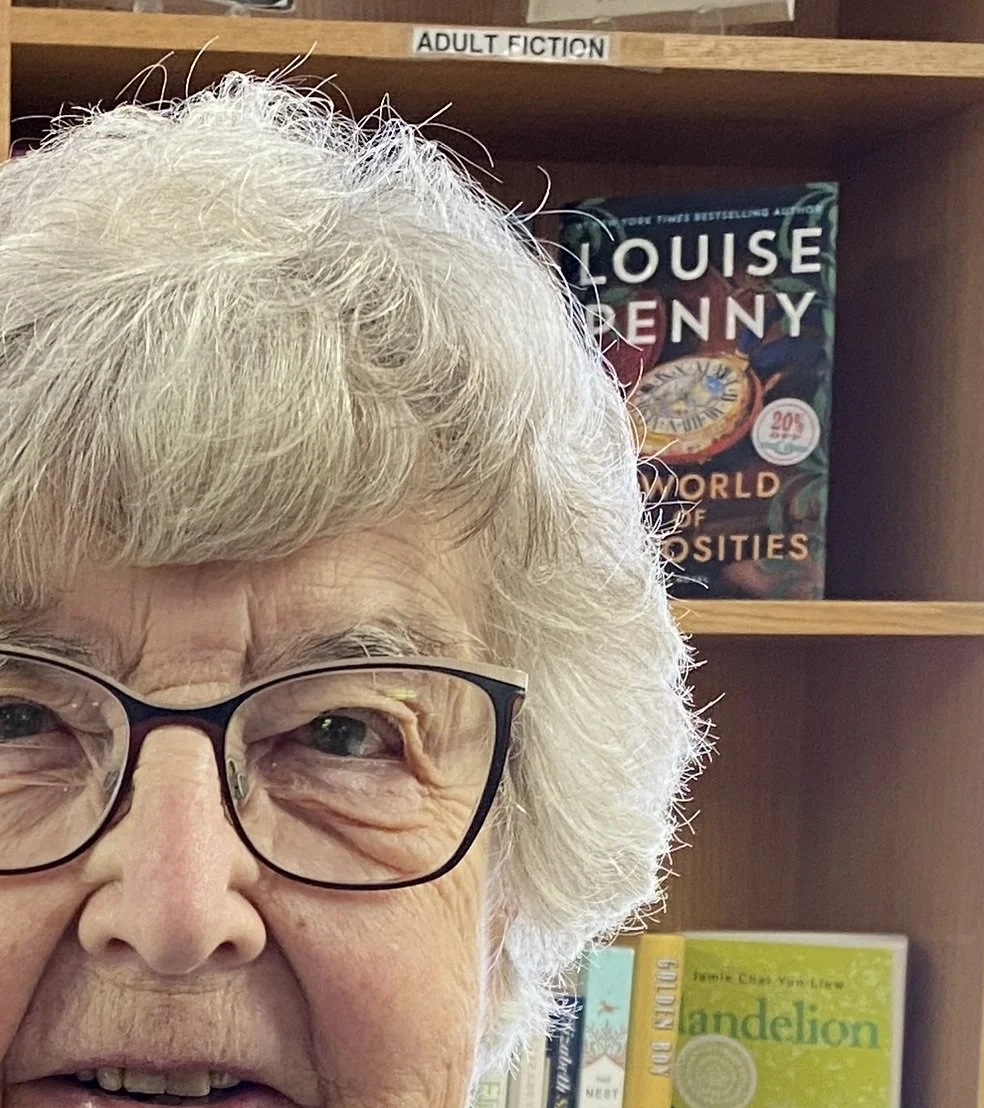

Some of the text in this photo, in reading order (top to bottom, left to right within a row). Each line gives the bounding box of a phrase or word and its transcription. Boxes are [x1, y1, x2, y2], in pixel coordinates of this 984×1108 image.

[416, 31, 605, 58] ADULT FICTION
[656, 212, 691, 225] TIMES
[693, 207, 770, 223] BESTSELLING
[579, 226, 823, 287] LOUISE
[585, 291, 816, 347] PENNY
[770, 410, 805, 435] 20%
[638, 471, 781, 501] WORLD
[662, 532, 809, 565] OSITIES
[648, 959, 679, 1078] GOLDEN BOY
[555, 1022, 577, 1094] lizabeth
[585, 1087, 619, 1100] NEST
